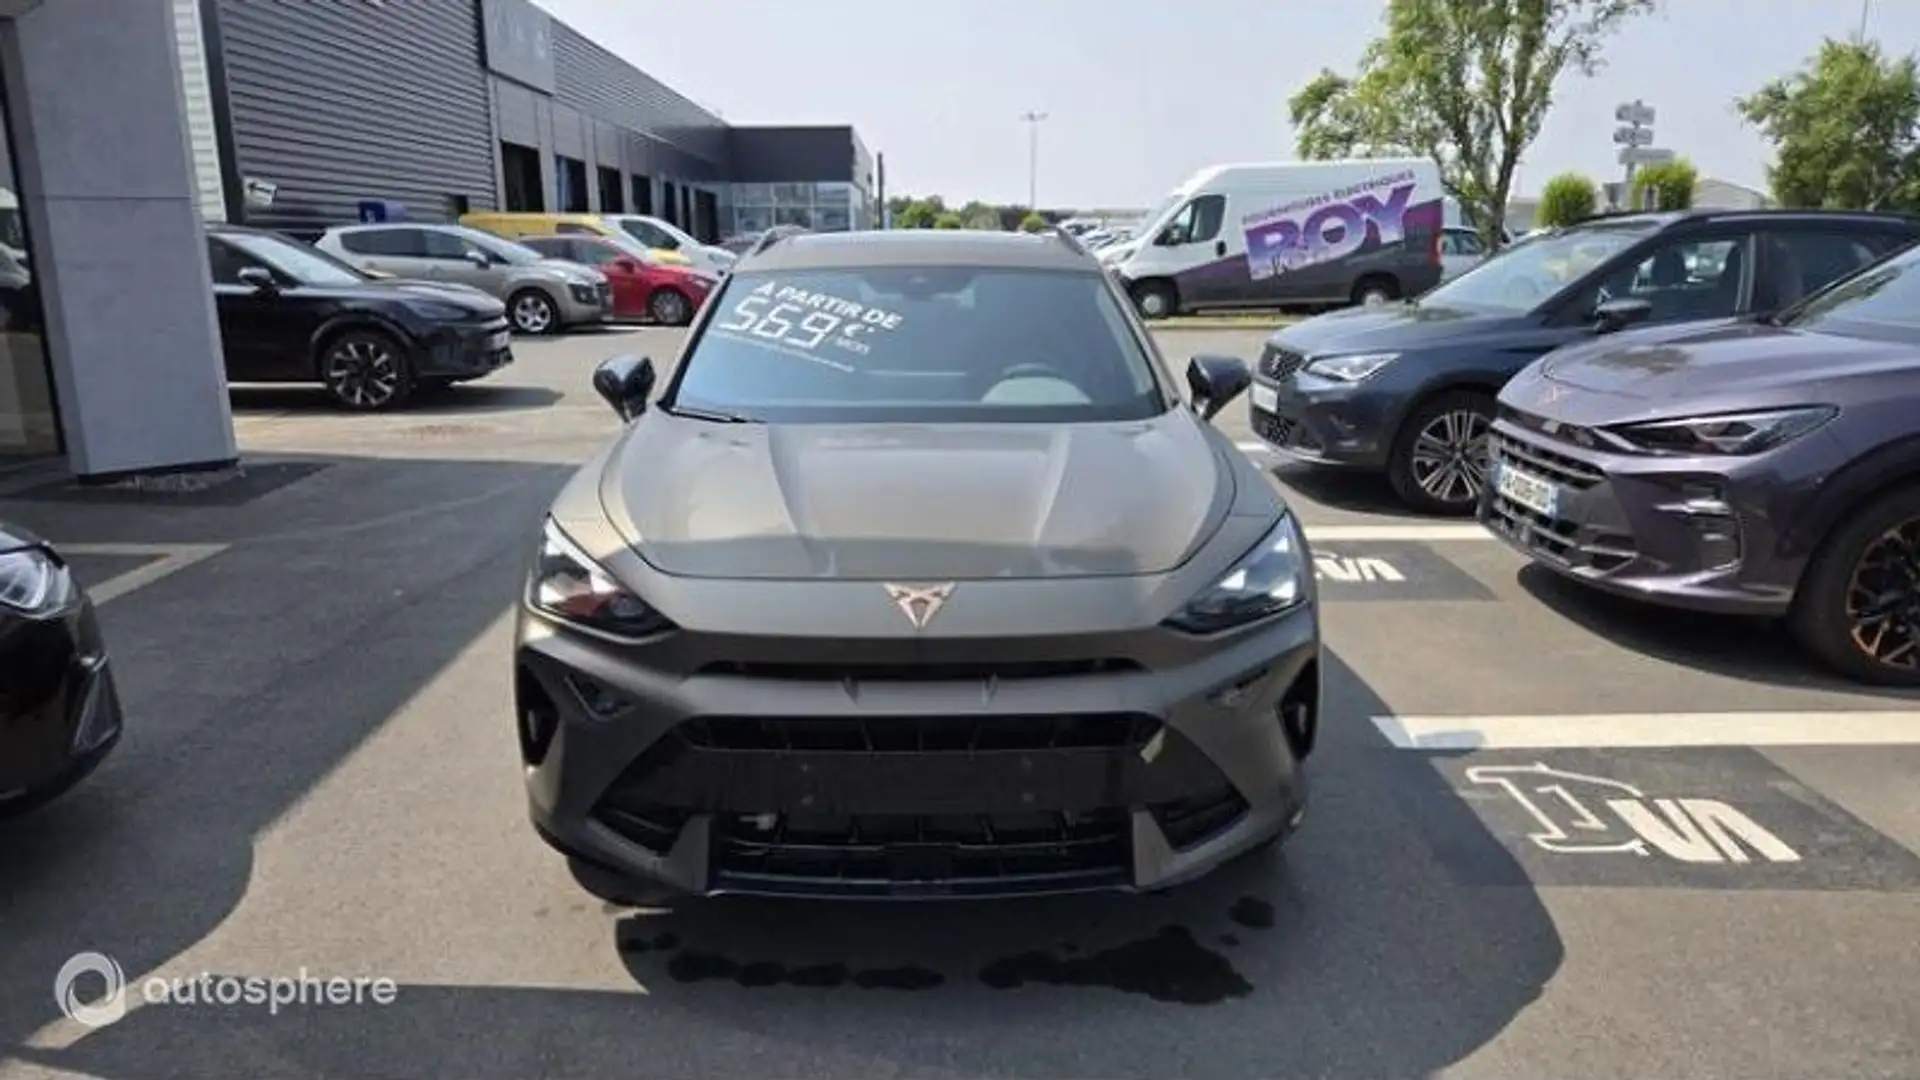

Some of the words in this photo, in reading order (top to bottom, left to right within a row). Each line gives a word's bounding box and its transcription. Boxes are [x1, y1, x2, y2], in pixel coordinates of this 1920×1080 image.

[718, 296, 842, 349] 569
[776, 286, 862, 317] PARTIR
[862, 310, 903, 330] DE
